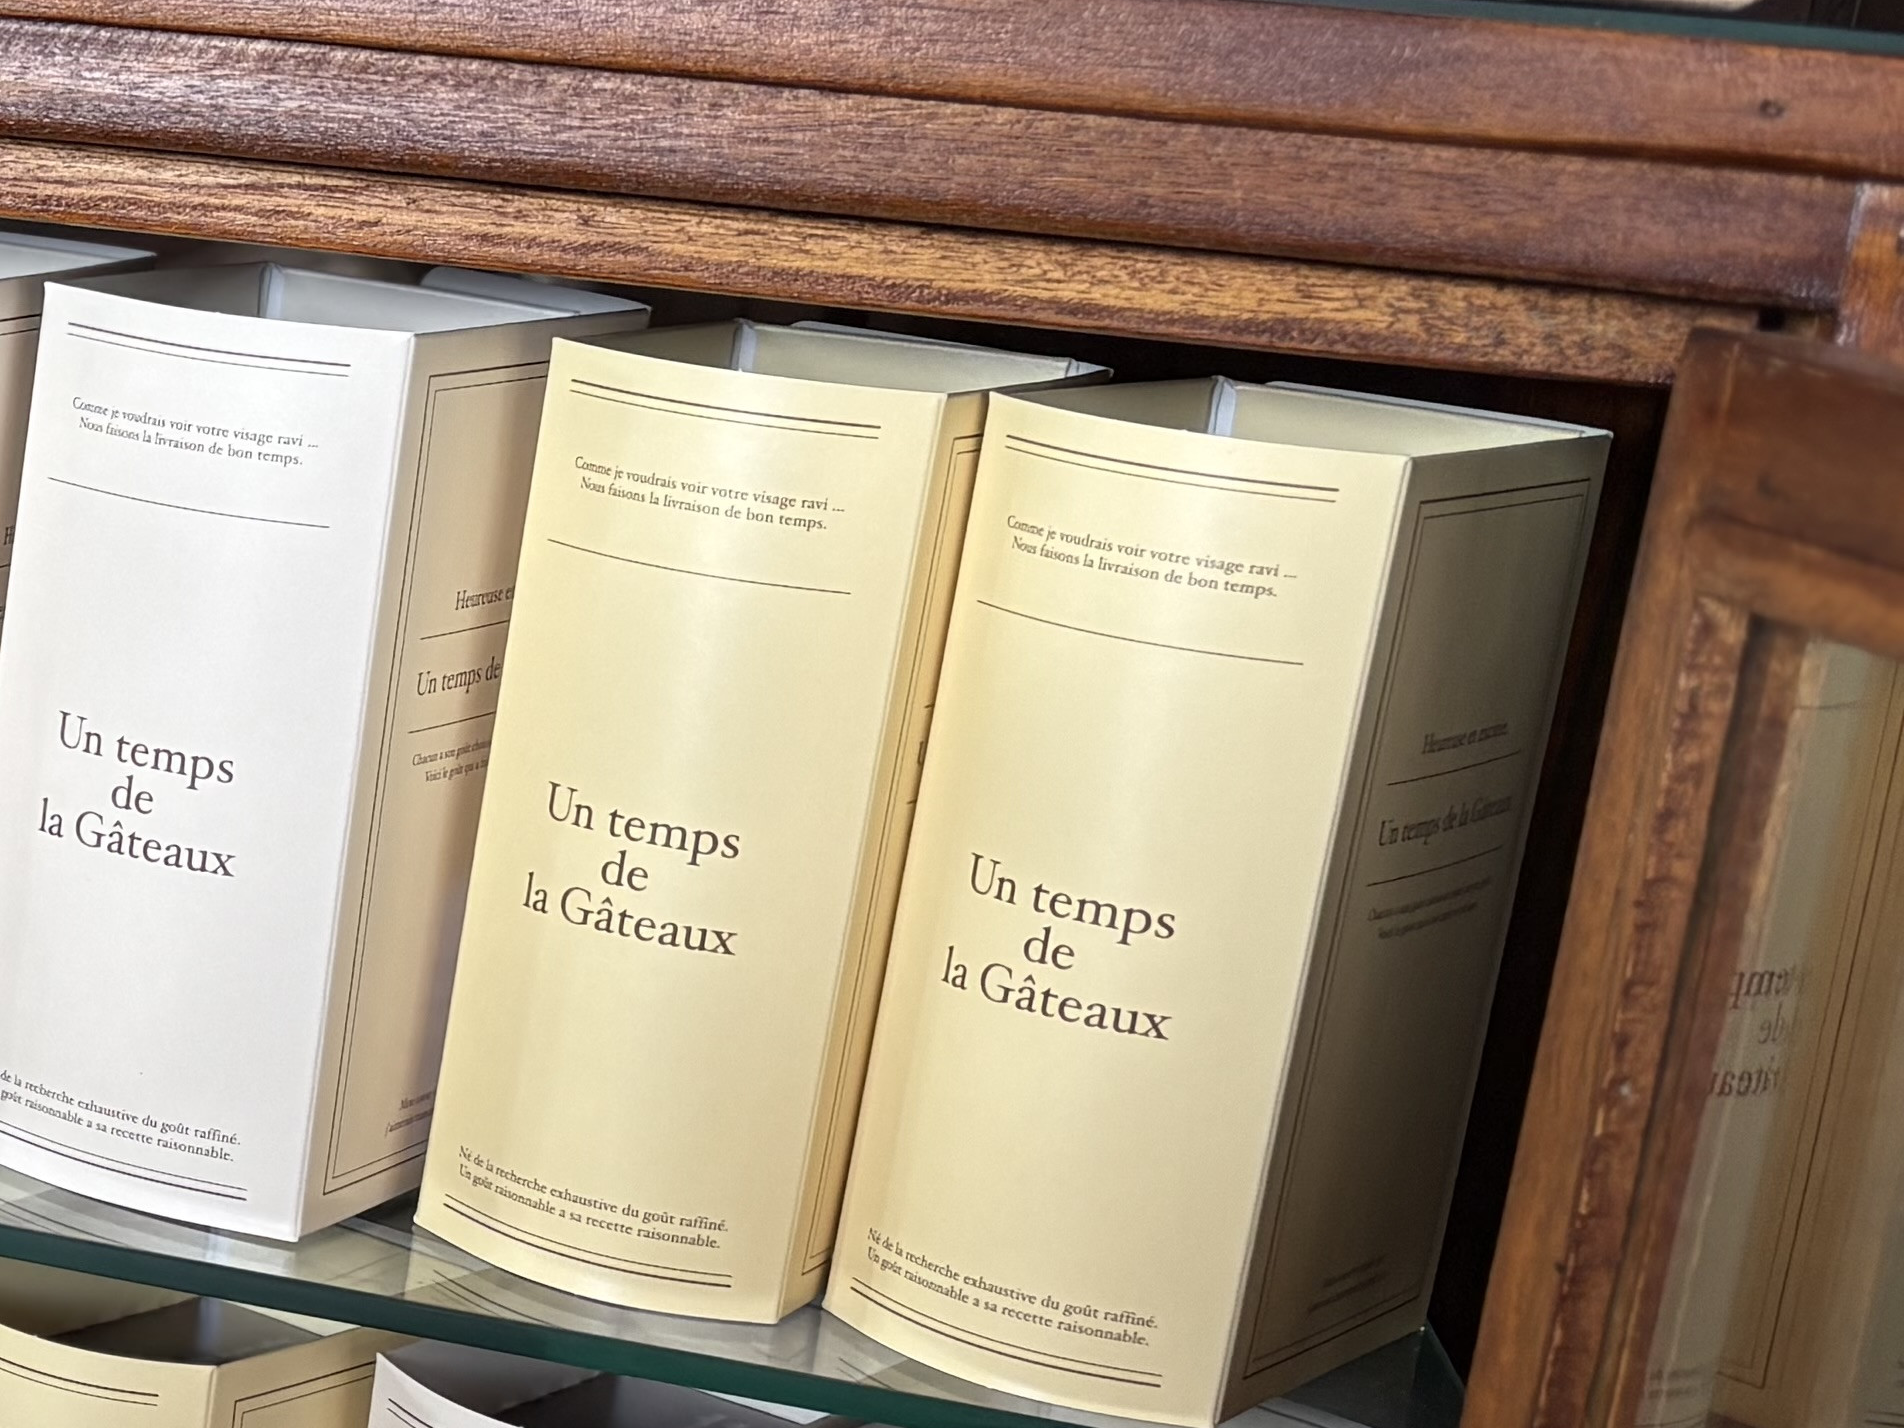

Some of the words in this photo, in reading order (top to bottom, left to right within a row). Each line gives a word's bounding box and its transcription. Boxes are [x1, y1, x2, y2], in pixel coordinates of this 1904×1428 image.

[1007, 514, 1045, 539] Comme
[1045, 526, 1057, 544] je
[1059, 527, 1114, 553] voudrais
[1117, 543, 1146, 559] voir
[1149, 548, 1191, 566] votre
[1195, 554, 1244, 577] visage
[1248, 561, 1281, 578] ravi
[1011, 534, 1038, 557] Nous
[1038, 543, 1080, 566] faisons
[1082, 552, 1094, 569] la
[1098, 555, 1160, 581] livraison
[1163, 569, 1183, 585] de
[1187, 571, 1219, 590] bon
[1223, 581, 1278, 600] temps.
[59, 710, 103, 757] Un
[116, 735, 235, 791] temps
[111, 774, 154, 815] de
[548, 780, 594, 830] Un
[608, 809, 741, 867] temps
[38, 797, 64, 838] la
[75, 810, 236, 877] Gâteaux
[601, 849, 649, 892] de
[522, 871, 549, 915] la
[560, 886, 738, 956] Gâteaux
[971, 852, 1017, 905] Un
[1032, 882, 1176, 947] temps
[1023, 925, 1076, 970] de
[941, 945, 968, 990] la
[979, 962, 1173, 1041] Gâteaux
[867, 1227, 882, 1244] Né
[882, 1234, 894, 1250] de
[895, 1240, 904, 1258] la
[904, 1251, 960, 1282] recherche
[963, 1272, 1037, 1305] exhaustive
[1041, 1294, 1060, 1311] du
[1062, 1300, 1099, 1320] goût
[1103, 1308, 1158, 1329] raffiné.
